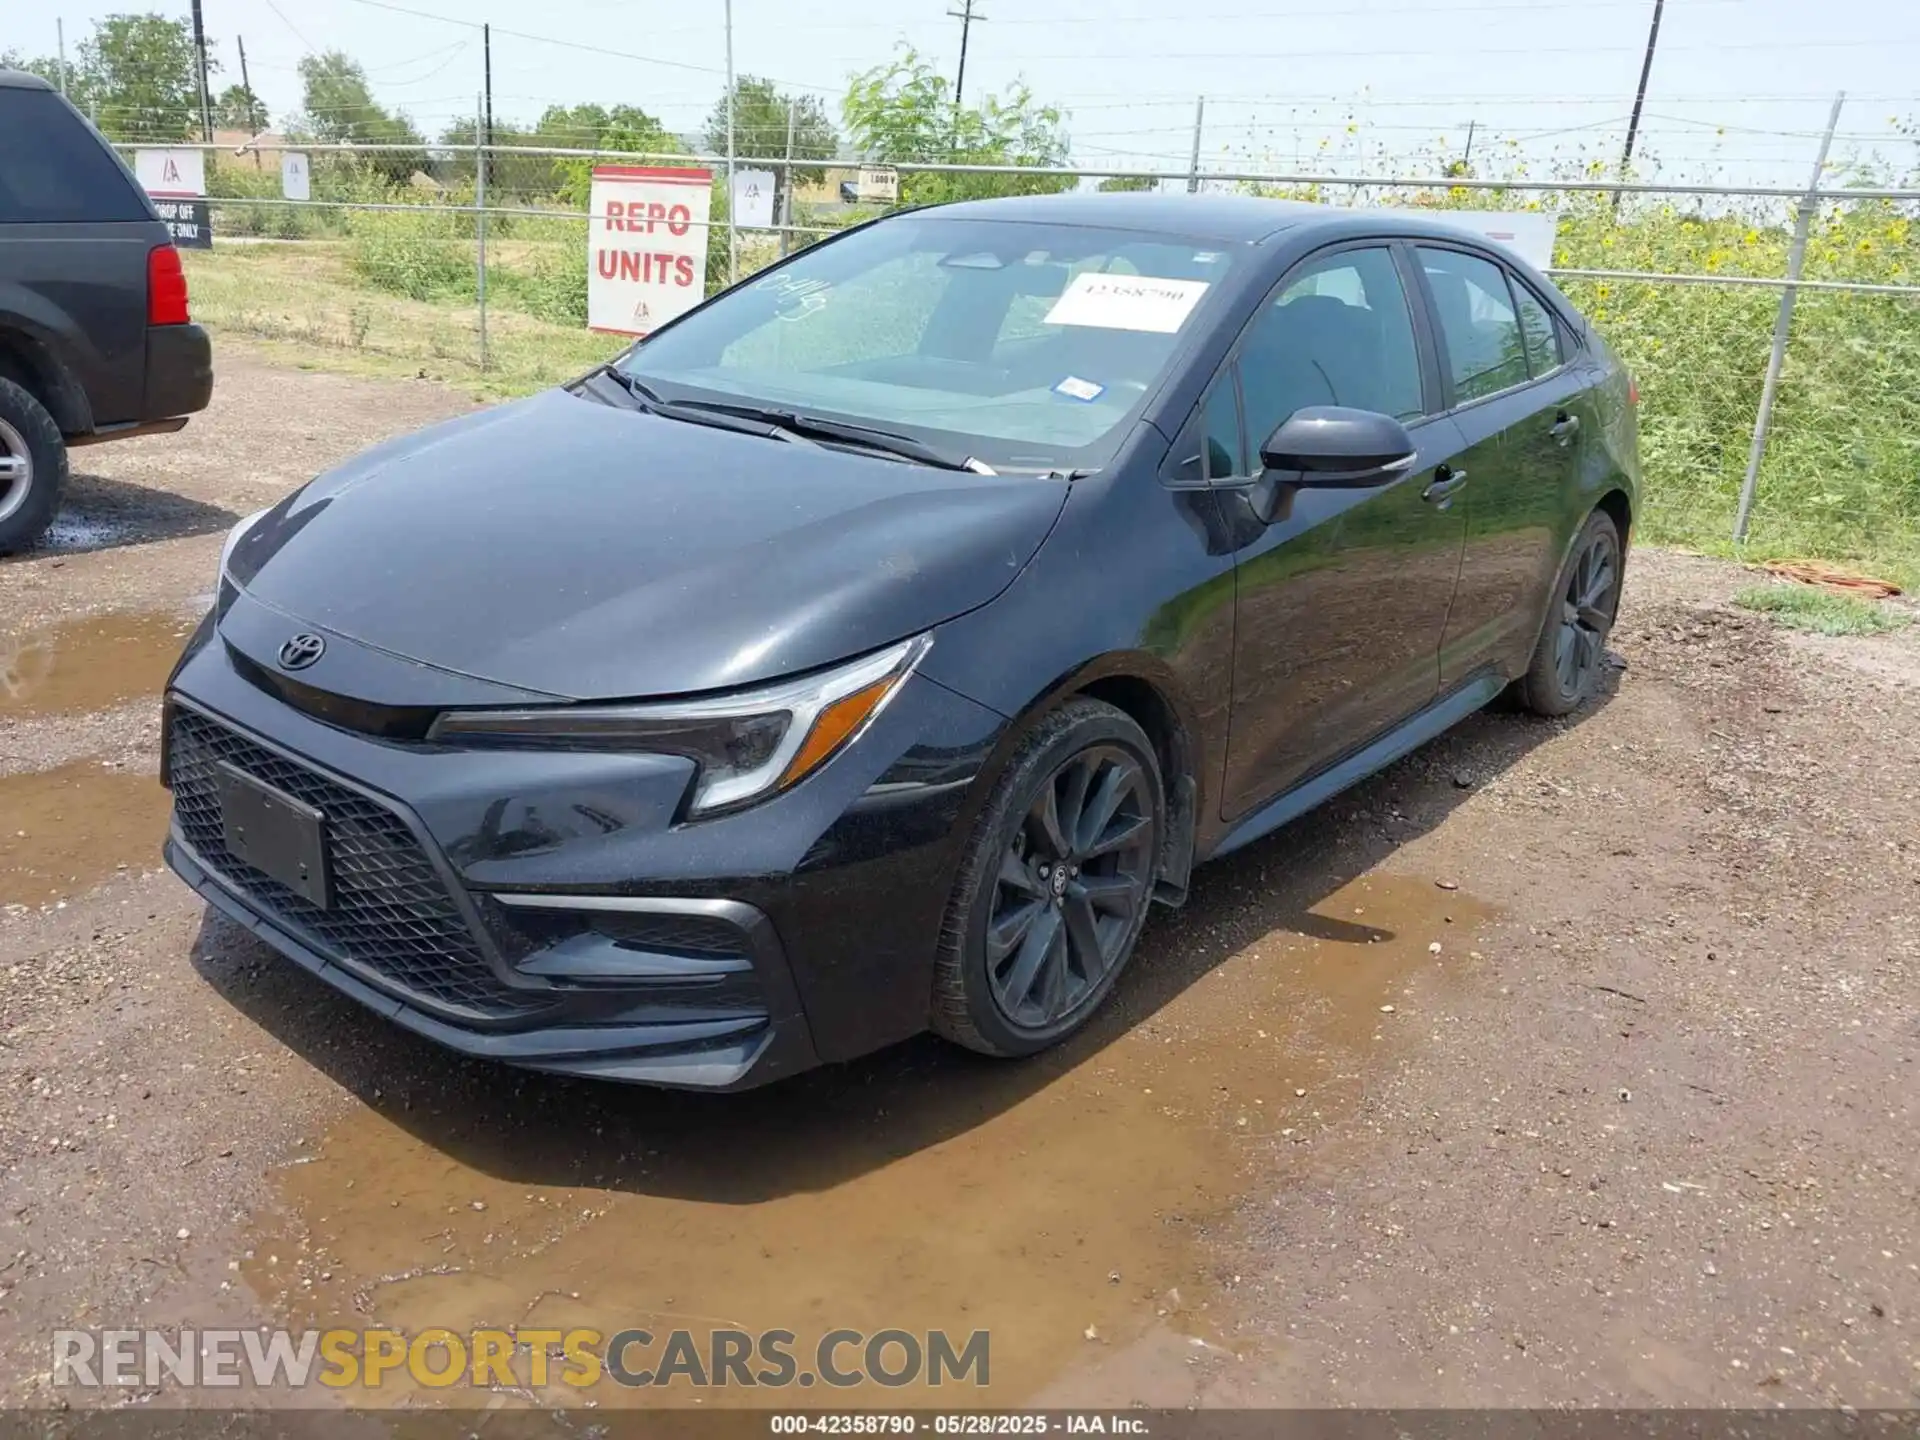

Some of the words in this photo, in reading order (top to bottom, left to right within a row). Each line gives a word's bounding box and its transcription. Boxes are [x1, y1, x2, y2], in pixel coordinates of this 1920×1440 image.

[178, 203, 194, 219] OFF
[605, 200, 691, 236] REPO
[176, 222, 198, 239] ONLY
[598, 249, 694, 287] UNITS
